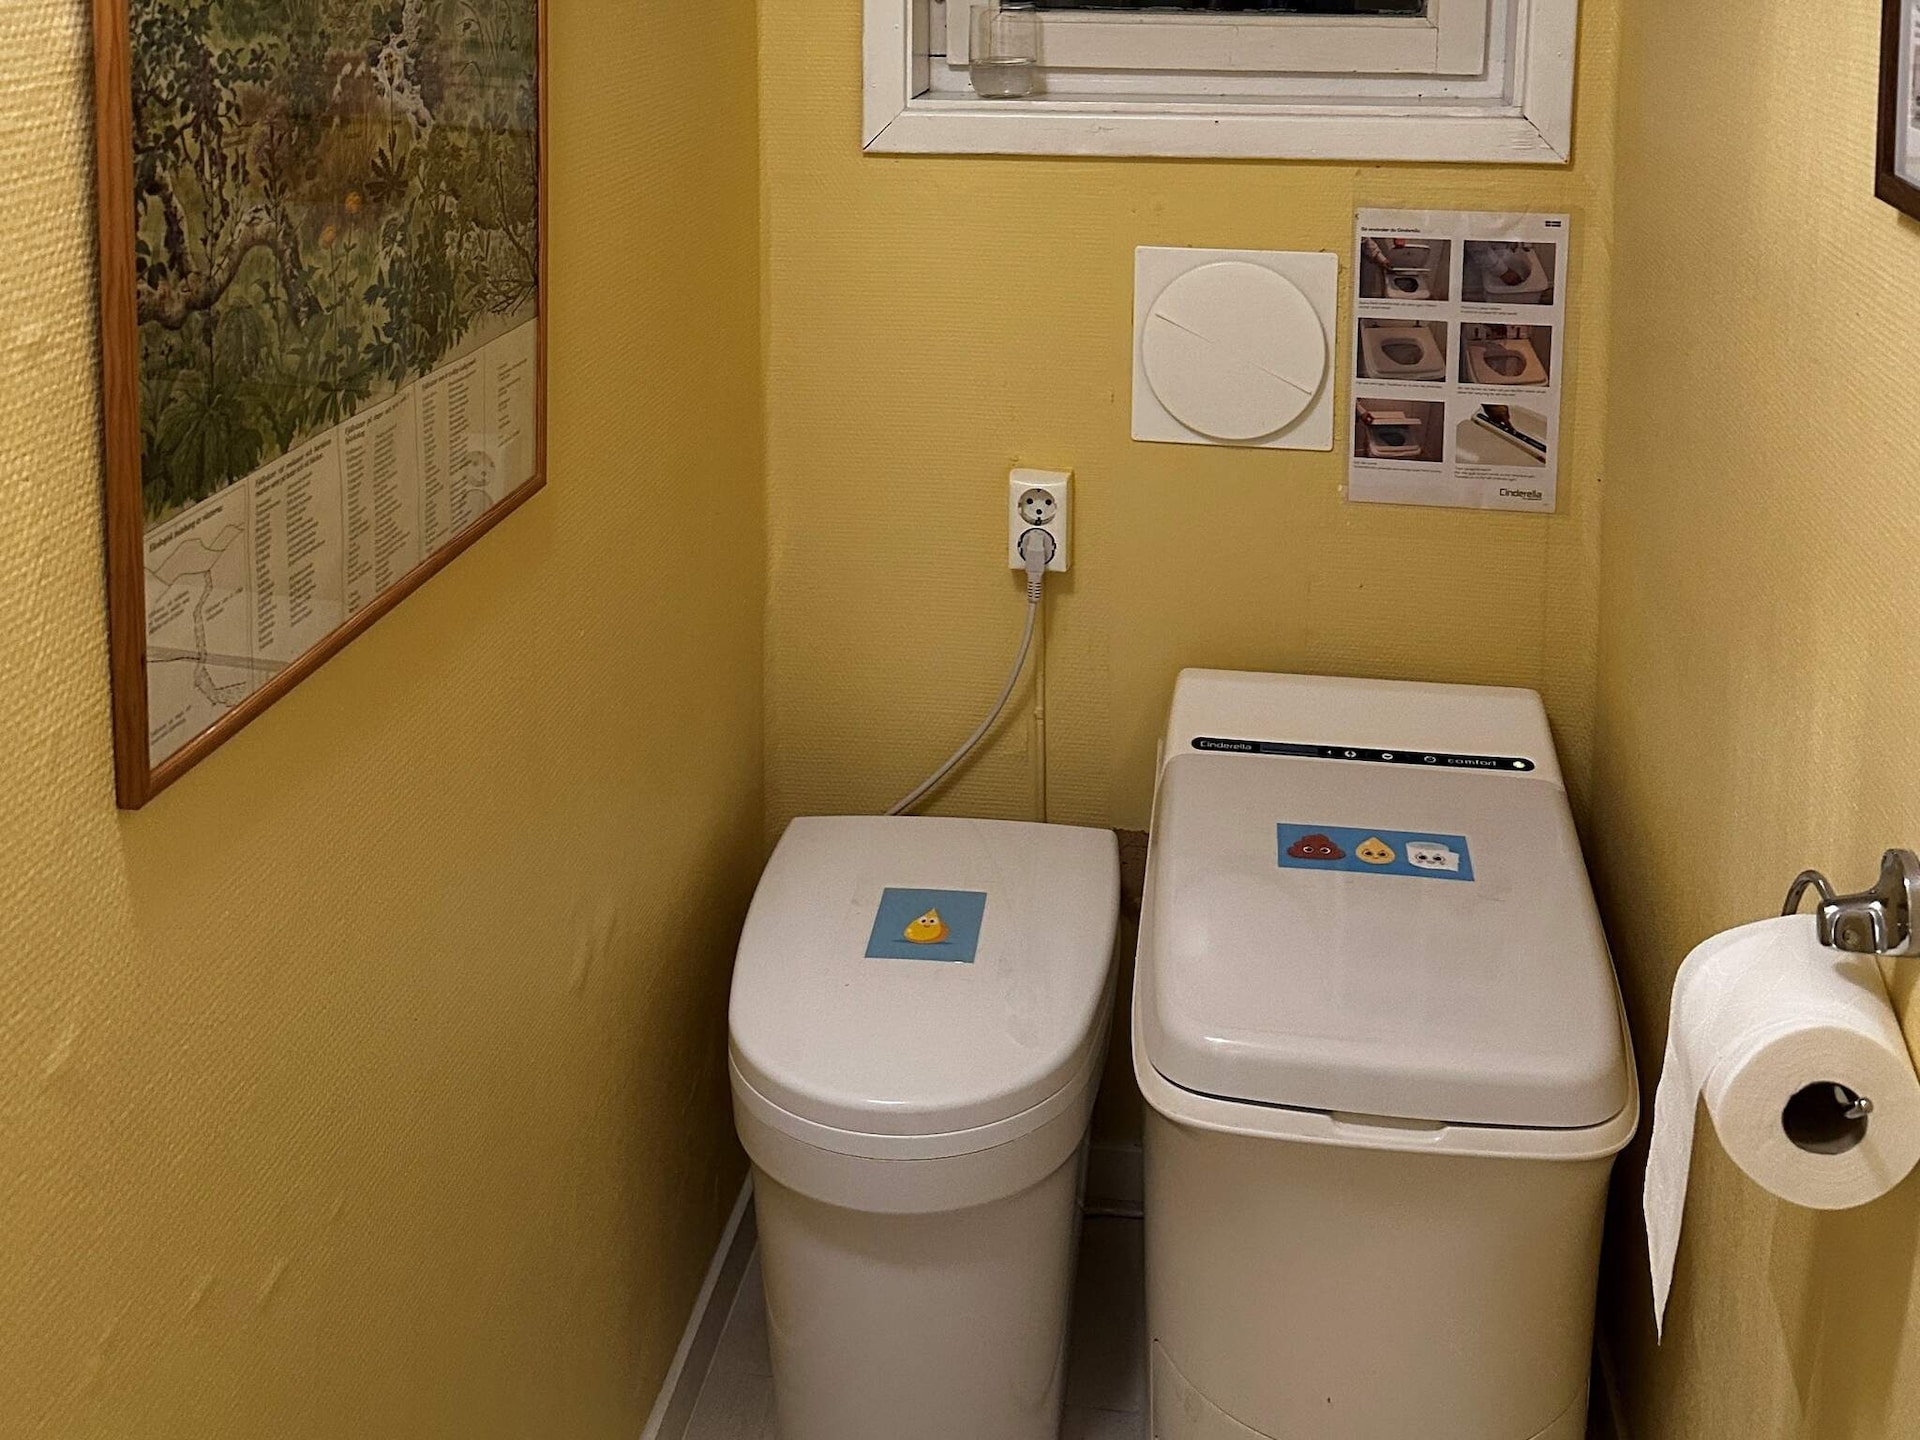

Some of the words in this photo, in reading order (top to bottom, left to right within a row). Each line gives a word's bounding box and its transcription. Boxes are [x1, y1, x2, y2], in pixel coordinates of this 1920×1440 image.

[1499, 488, 1542, 498] Cinderella
[1200, 740, 1252, 750] Cinderella
[1447, 758, 1497, 766] comfort
